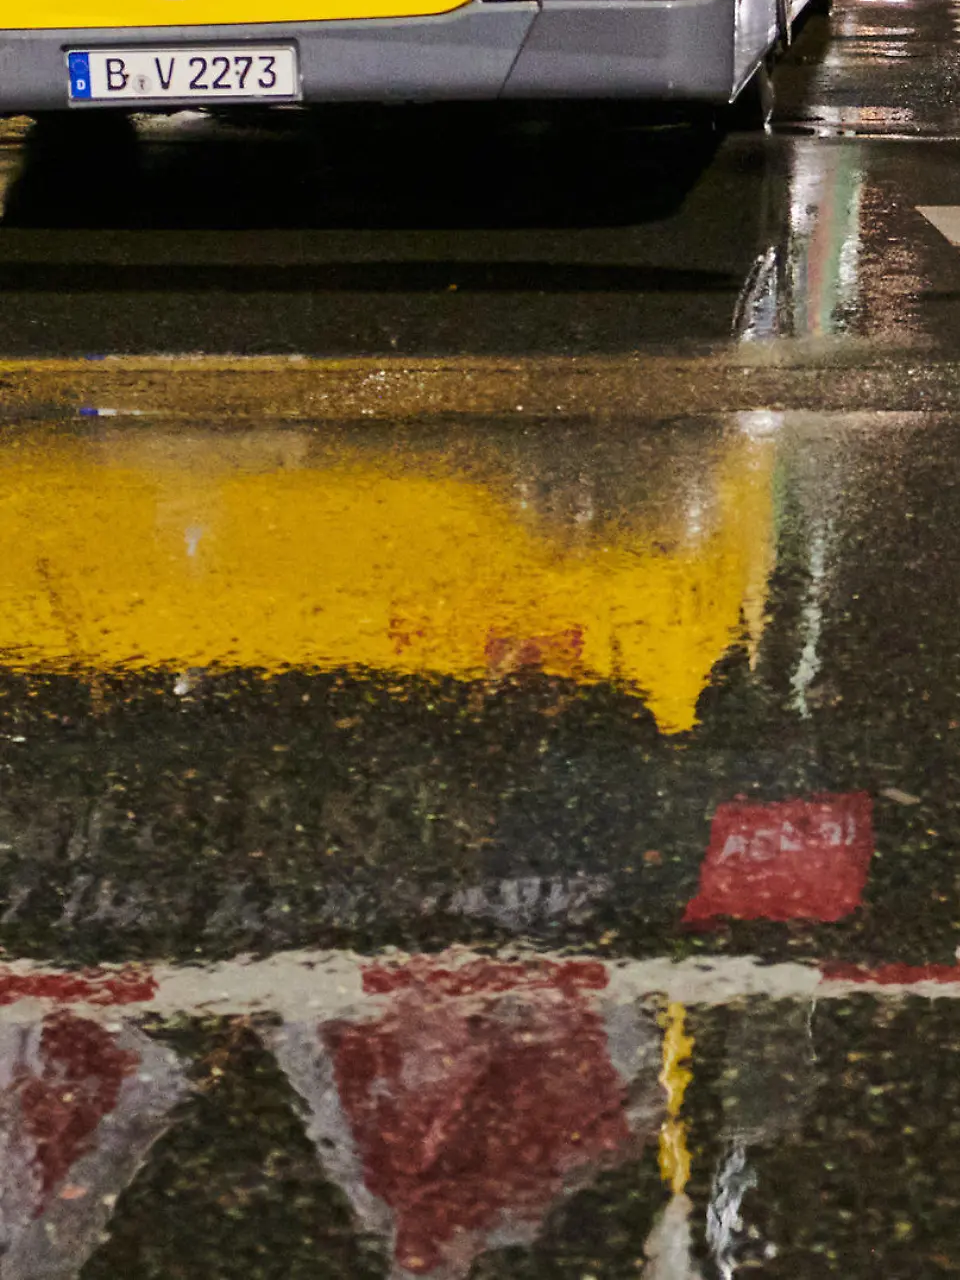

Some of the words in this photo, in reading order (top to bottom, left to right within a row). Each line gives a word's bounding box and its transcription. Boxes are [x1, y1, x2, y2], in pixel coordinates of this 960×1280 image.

[105, 58, 129, 91] B
[155, 57, 175, 90] V
[189, 56, 276, 90] 2273
